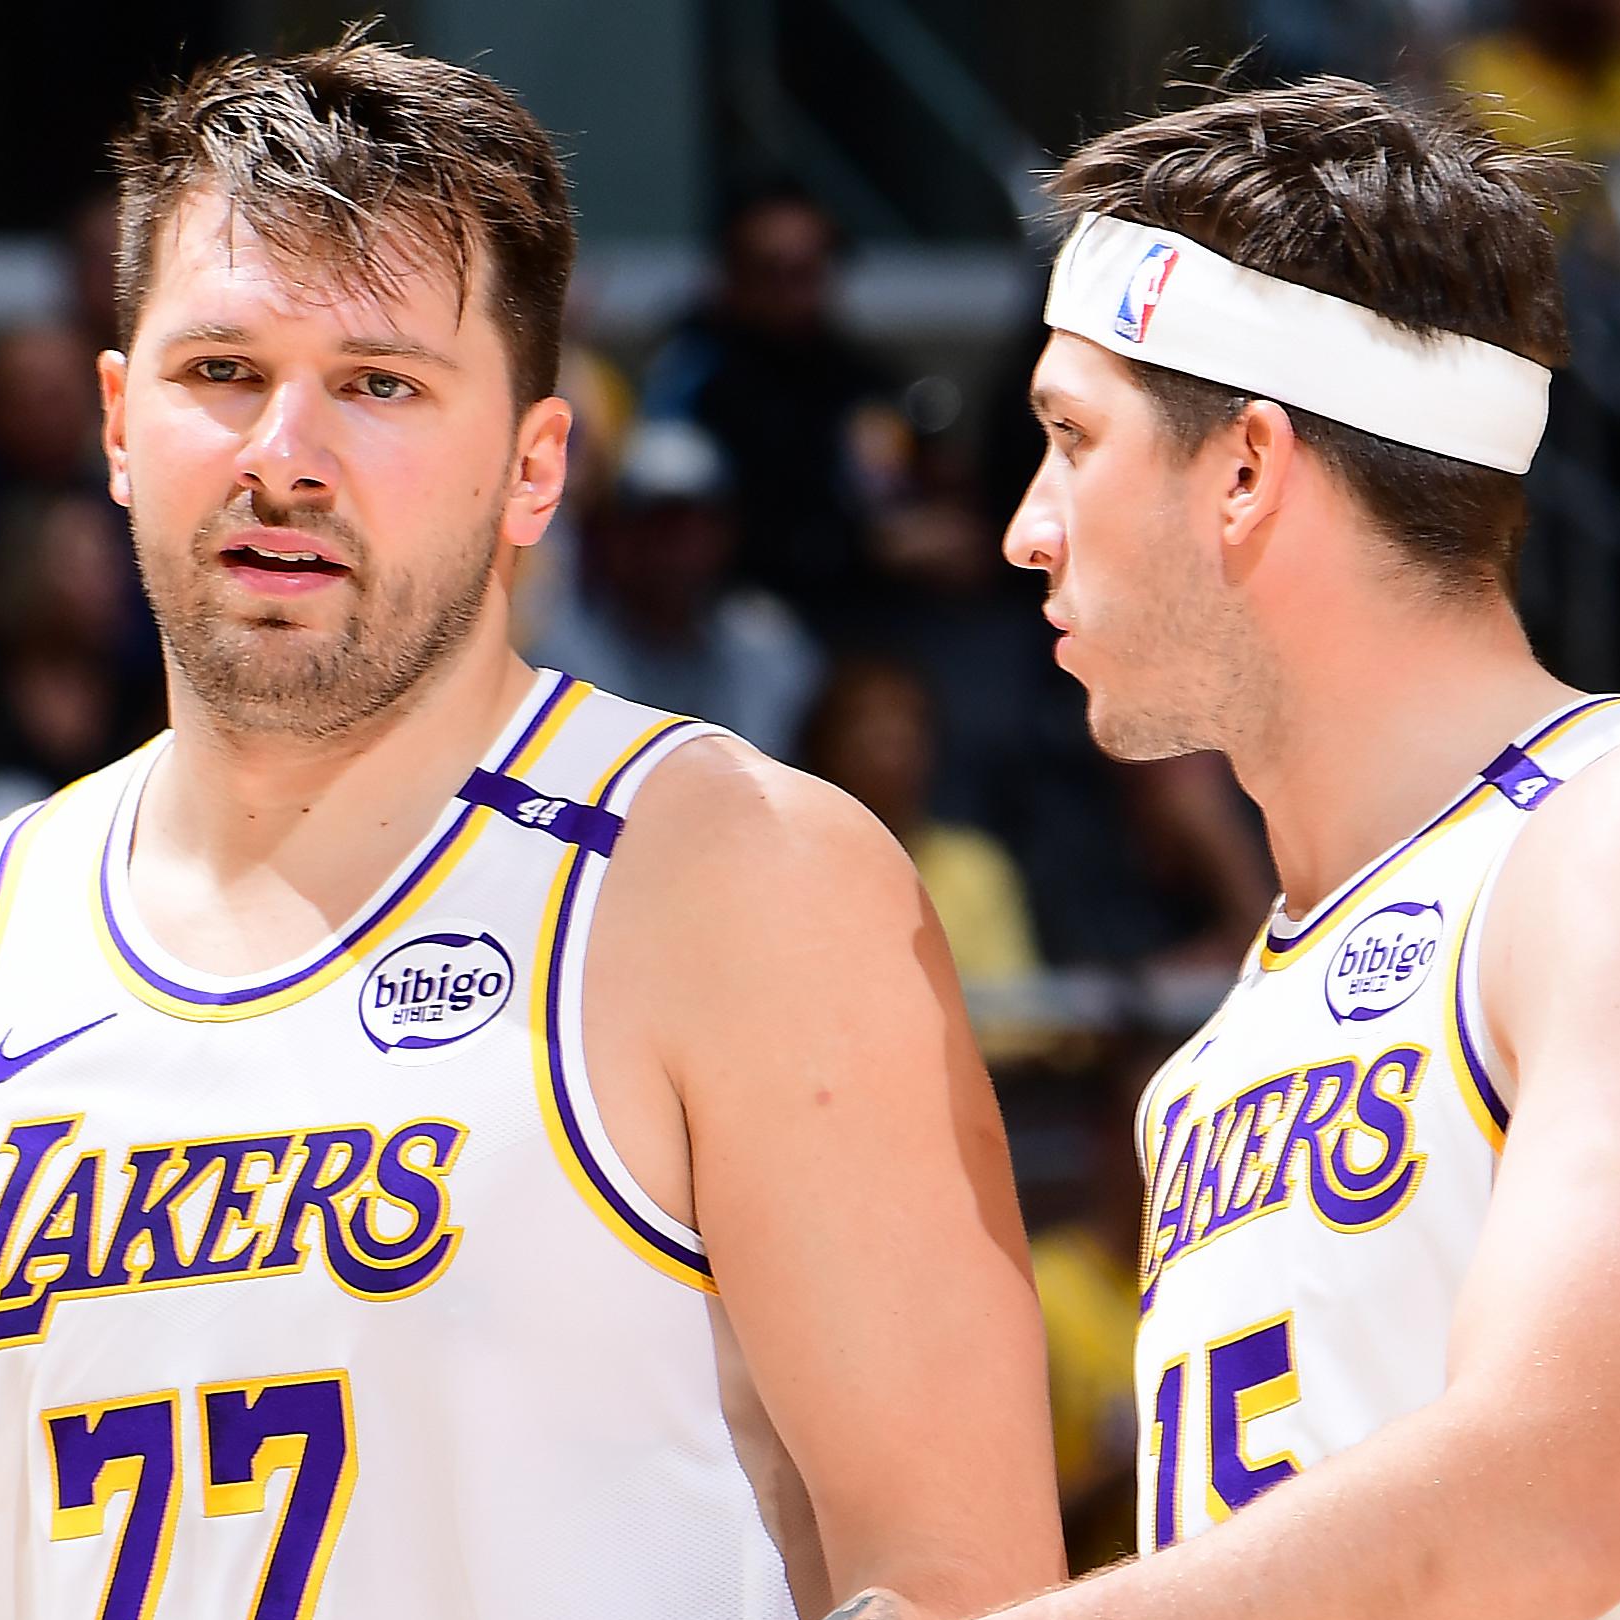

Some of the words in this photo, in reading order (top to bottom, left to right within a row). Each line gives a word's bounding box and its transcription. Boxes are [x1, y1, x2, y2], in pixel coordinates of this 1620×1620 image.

[1336, 932, 1437, 982] bibigo
[374, 963, 504, 1012] bibigo
[1149, 1306, 1306, 1552] 15
